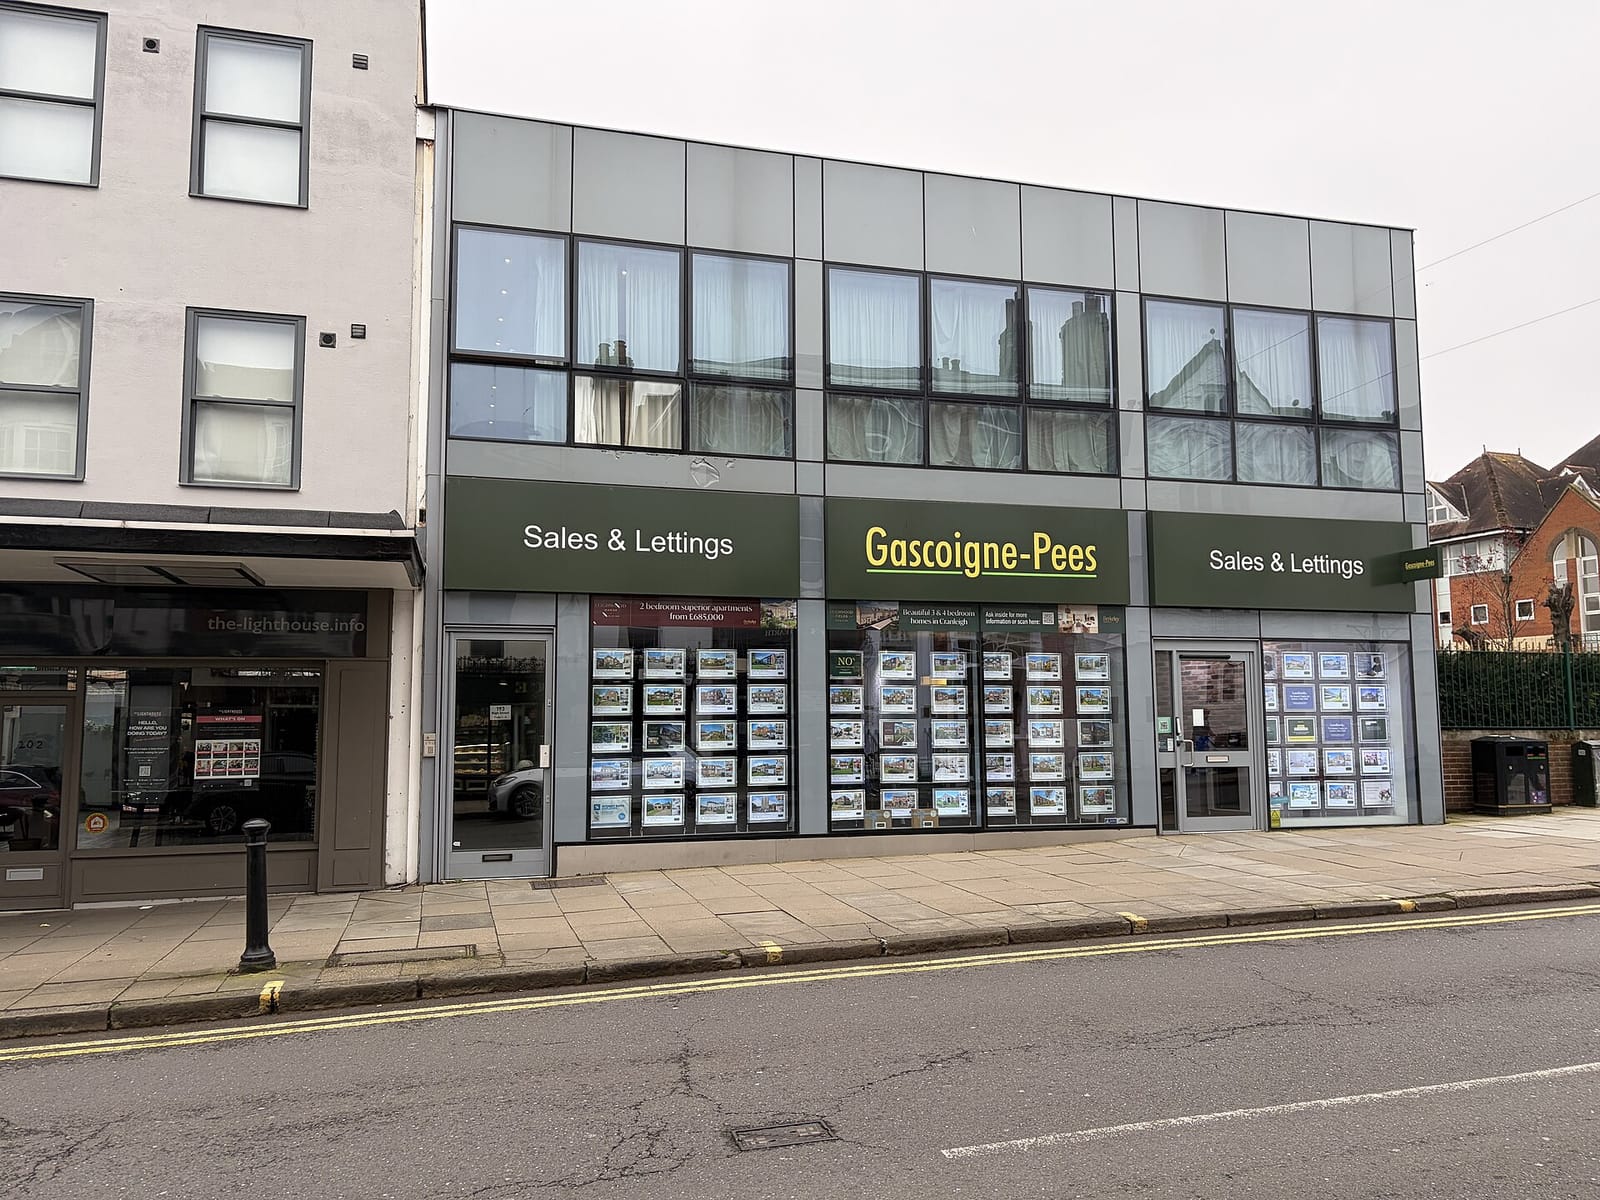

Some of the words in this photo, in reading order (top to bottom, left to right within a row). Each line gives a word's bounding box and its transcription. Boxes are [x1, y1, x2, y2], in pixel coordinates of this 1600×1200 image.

[523, 524, 599, 550] Sales
[607, 528, 627, 551] &
[635, 529, 735, 560] Lettings
[865, 526, 1098, 578] Gascoigne-Pees
[1209, 549, 1265, 572] Sales
[1270, 552, 1285, 572] &
[1290, 553, 1364, 579] Lettings
[645, 602, 680, 611] bedroom
[681, 603, 711, 613] superior
[711, 604, 753, 613] apartments
[902, 608, 931, 616] Beautiful
[947, 609, 976, 617] bedroom
[669, 612, 688, 620] from
[910, 617, 932, 625] homes
[932, 617, 939, 625] in
[939, 617, 969, 627] Cranleigh
[207, 615, 365, 635] the-lighthouse.info
